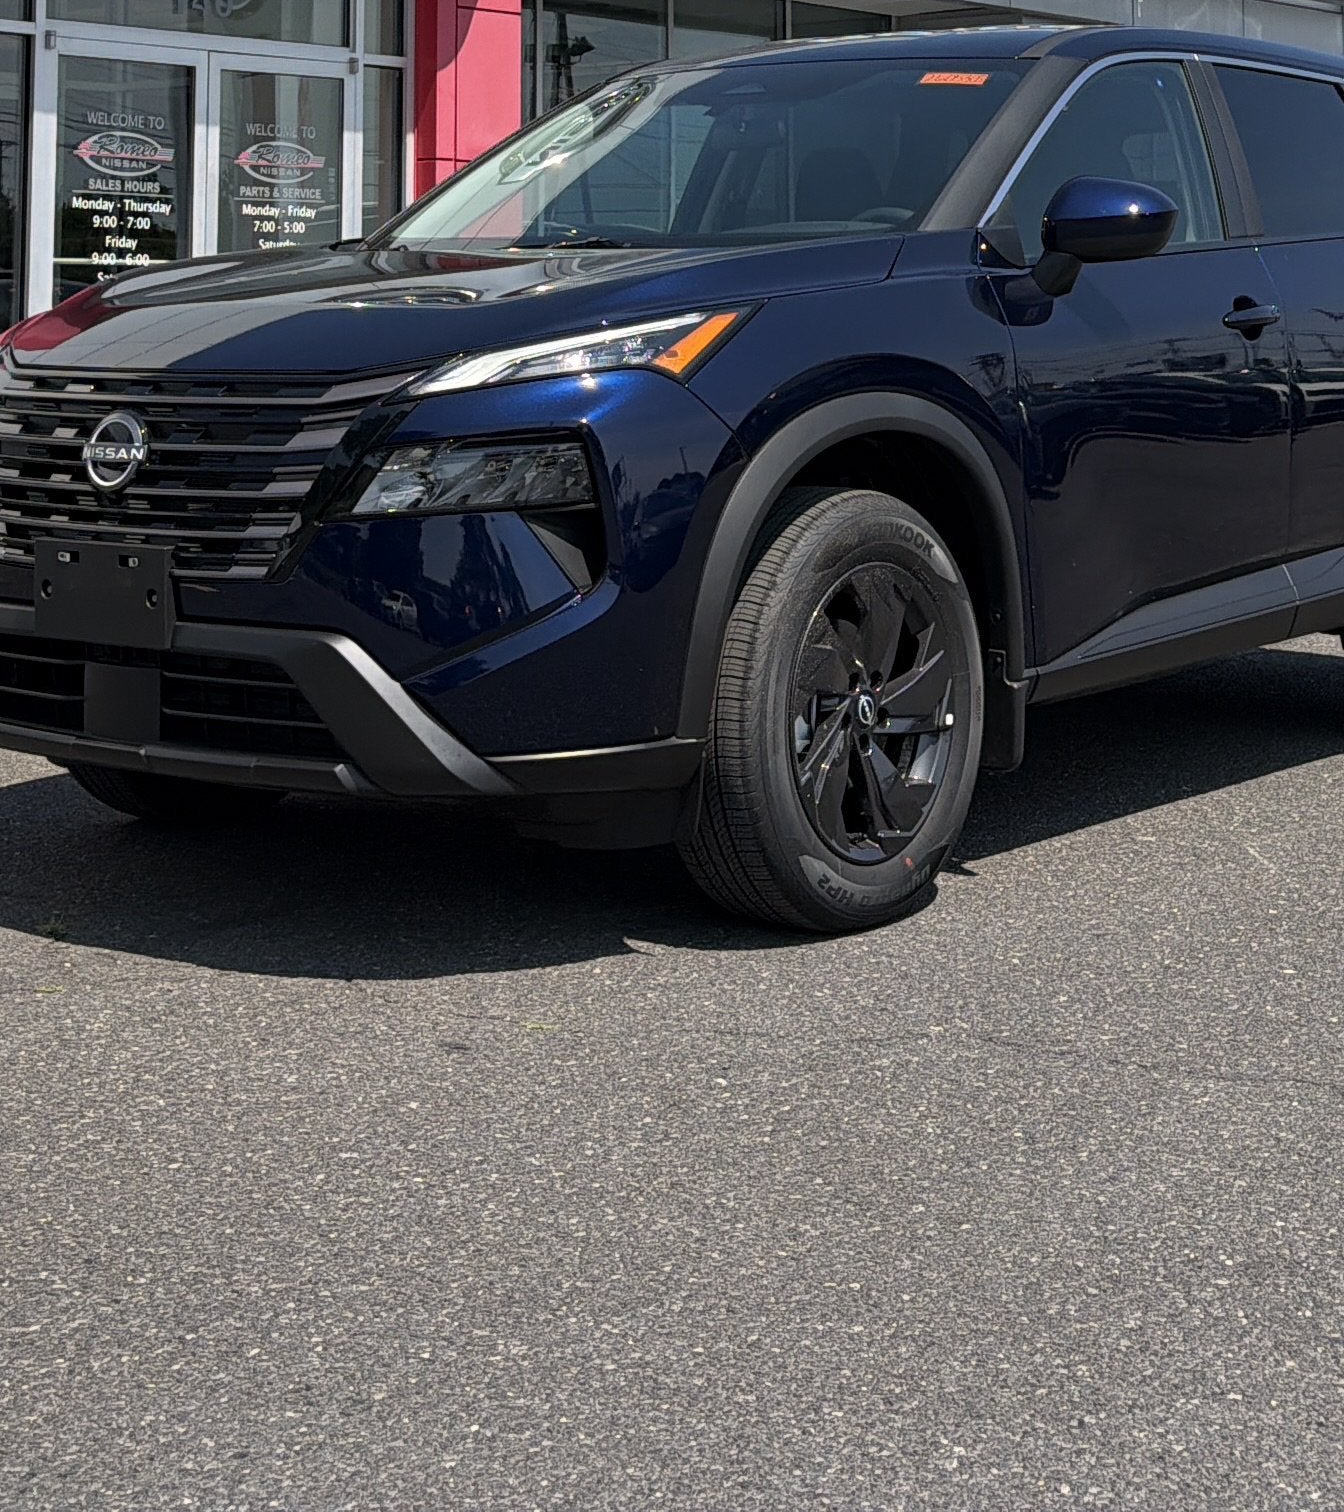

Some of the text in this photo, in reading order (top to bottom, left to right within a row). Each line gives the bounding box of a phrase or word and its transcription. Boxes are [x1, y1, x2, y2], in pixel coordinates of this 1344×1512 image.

[87, 111, 165, 130] WELCOME TO
[246, 123, 316, 139] WELCOME TO
[95, 135, 160, 158] Romeo
[256, 144, 311, 166] Romeo
[101, 157, 147, 170] NISSAN
[260, 167, 301, 177] NISSAN
[88, 178, 161, 194] SALES HOURS
[239, 185, 322, 200] PARTS & SERVICE
[72, 196, 115, 212] Monday
[123, 199, 172, 216] Thursday
[242, 204, 280, 219] Monday
[287, 205, 317, 220] Friday
[92, 215, 118, 228] 9:00
[127, 217, 151, 230] 7:00
[253, 220, 275, 233] 7:00
[283, 221, 306, 234] 5:00
[105, 235, 138, 250] Friday
[91, 252, 117, 265] 9:00
[125, 254, 150, 267] 6:00
[83, 446, 145, 460] NISSAN
